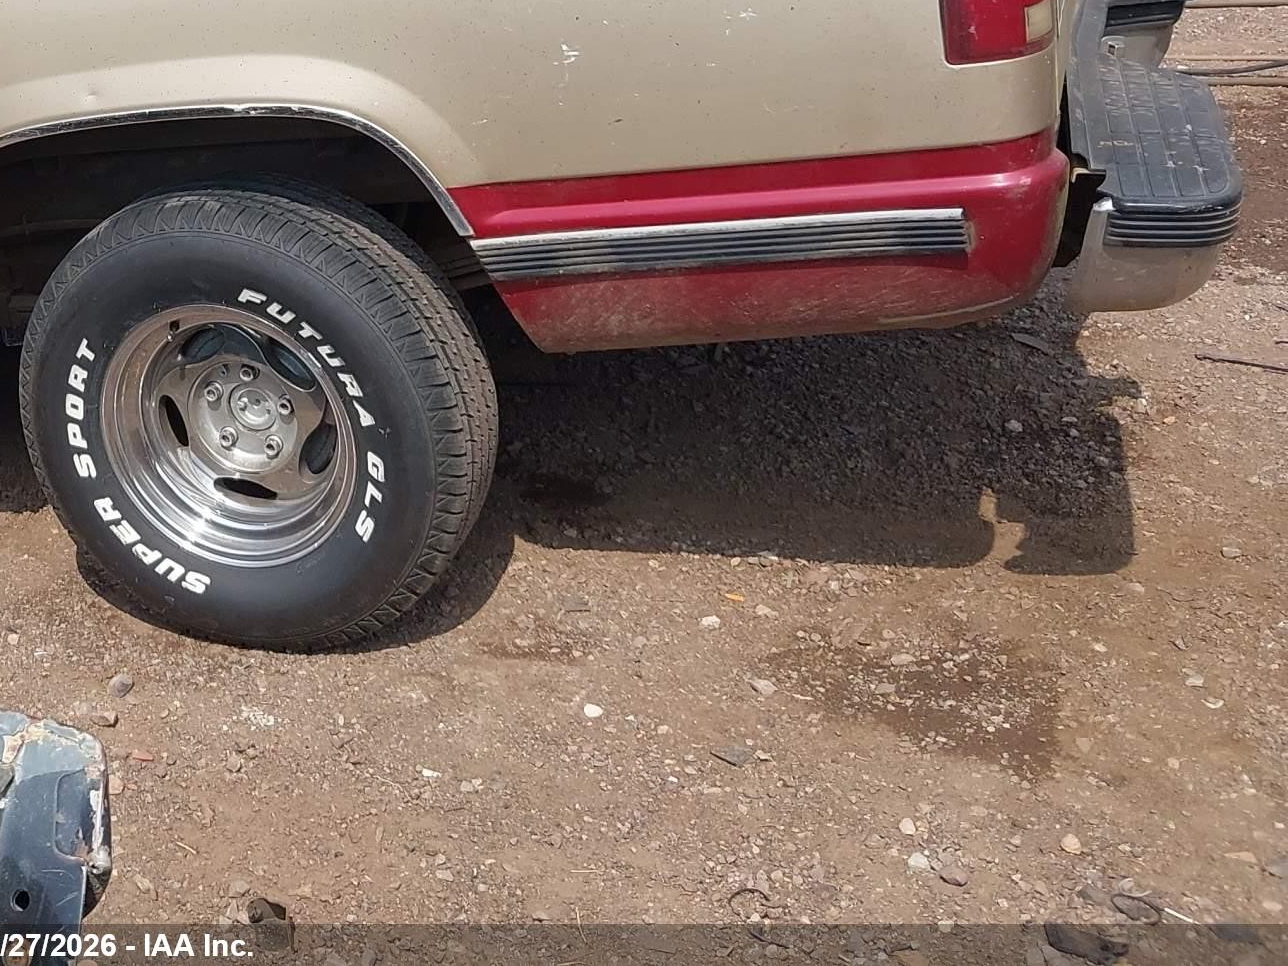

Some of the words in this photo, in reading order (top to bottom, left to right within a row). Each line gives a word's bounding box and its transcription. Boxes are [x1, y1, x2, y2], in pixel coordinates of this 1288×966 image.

[65, 337, 97, 480] SPORT
[237, 287, 376, 428] FUTURA
[354, 450, 385, 543] GLS
[93, 496, 212, 595] SUPER
